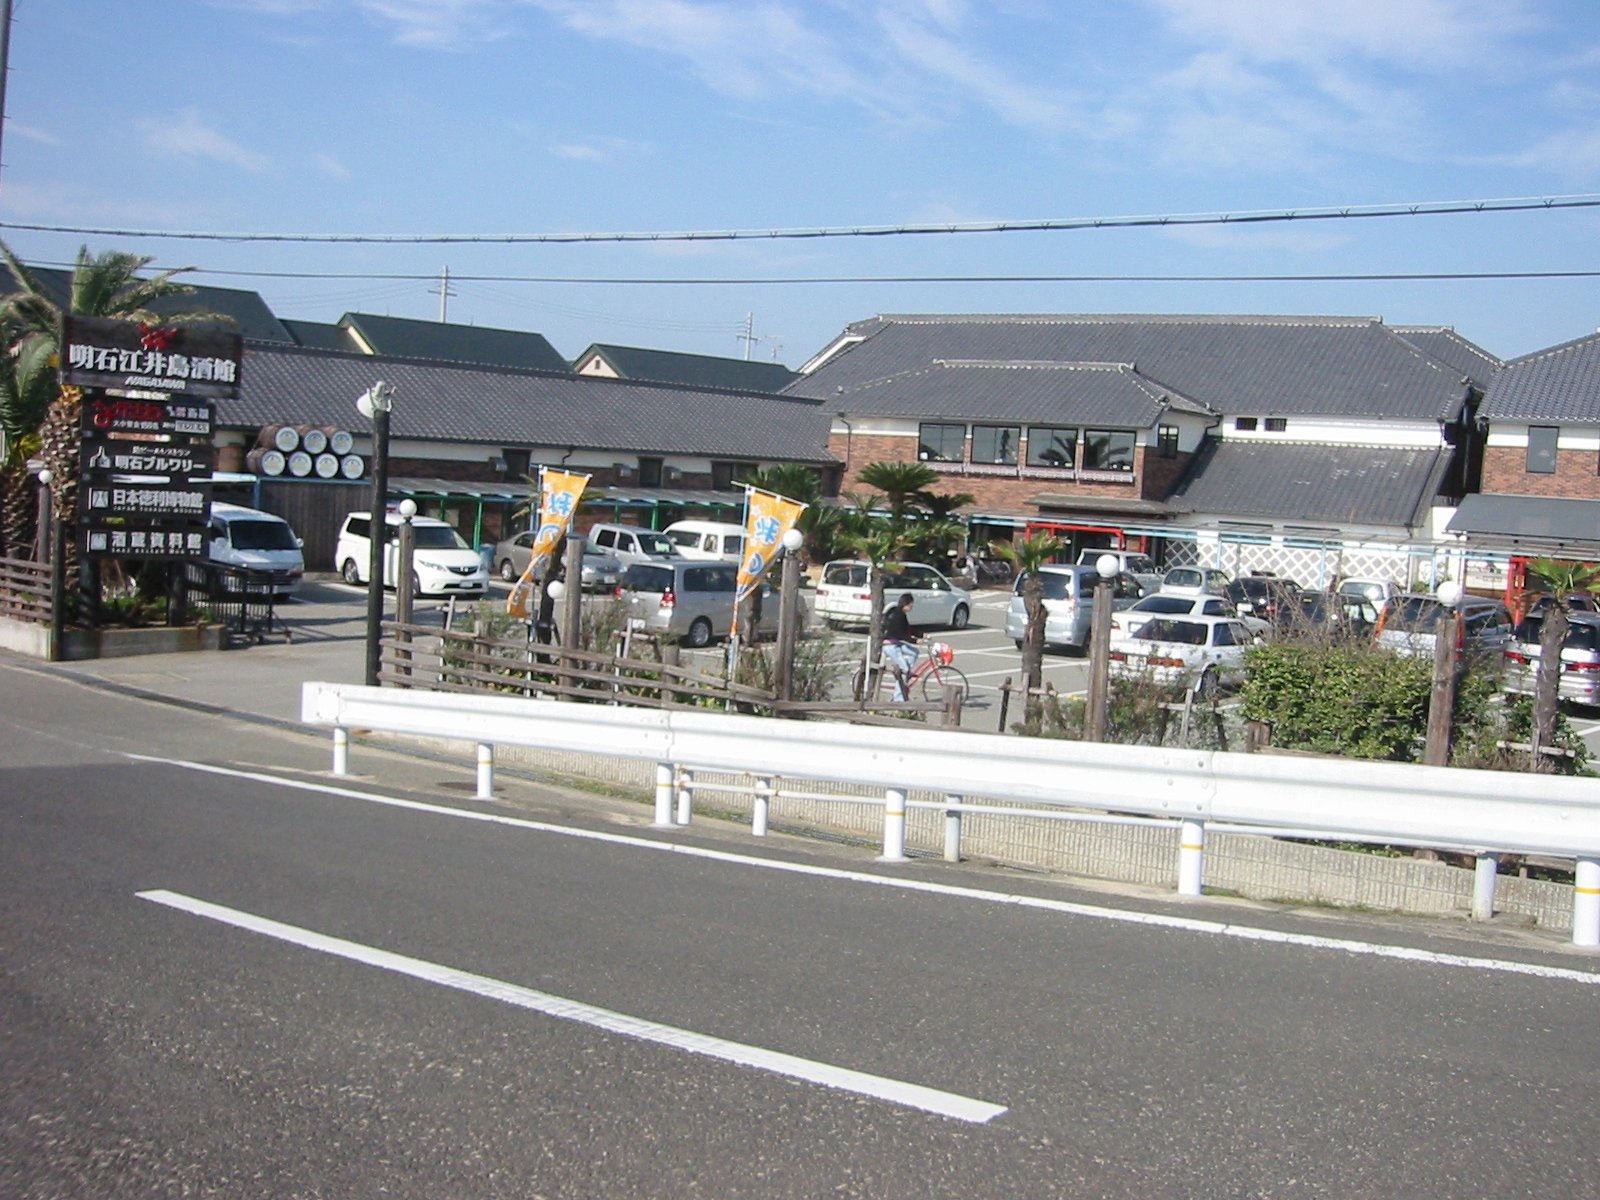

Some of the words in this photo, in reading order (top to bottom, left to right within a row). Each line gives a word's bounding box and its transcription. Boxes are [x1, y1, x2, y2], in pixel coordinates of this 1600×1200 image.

[69, 343, 237, 383] 明石江井島酒館
[115, 455, 206, 473] 明石ブルワリー
